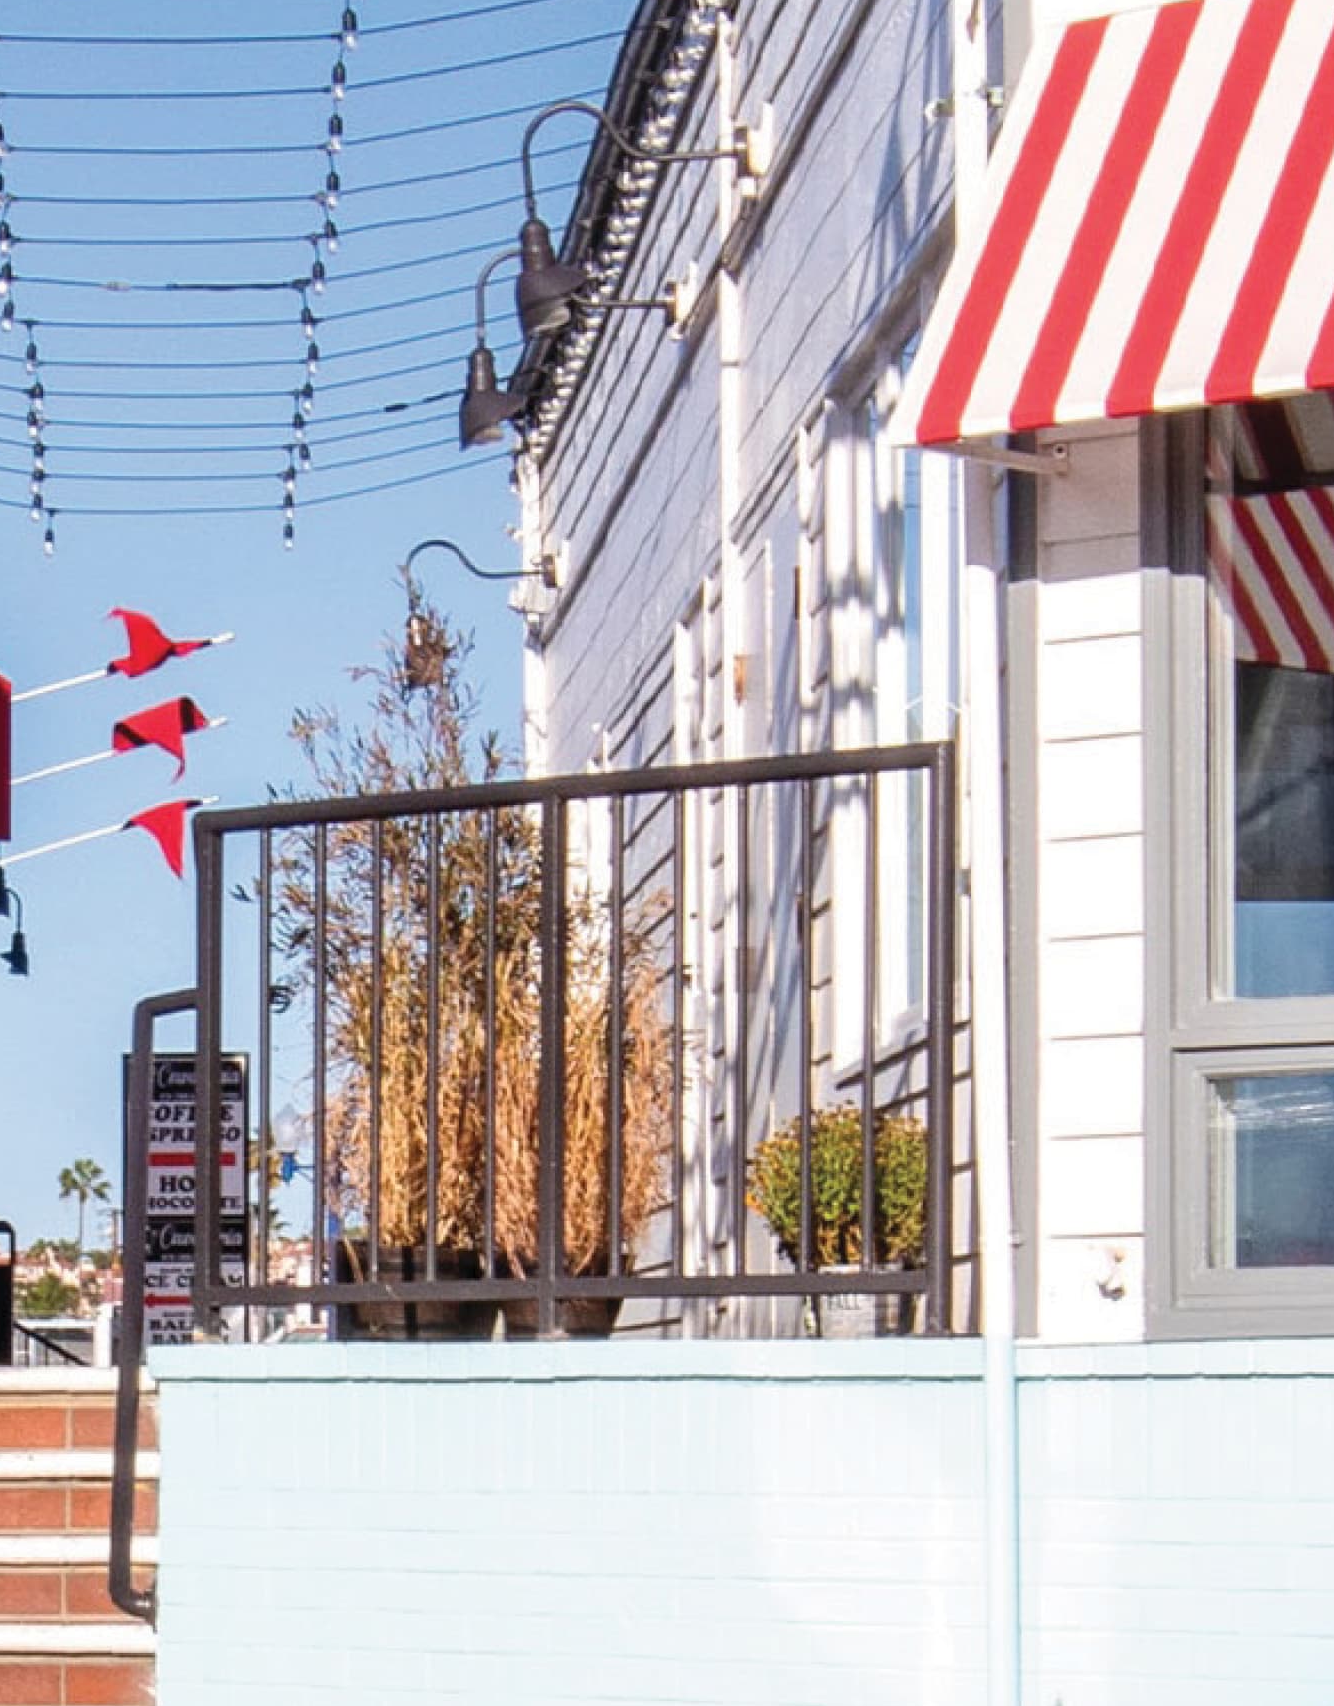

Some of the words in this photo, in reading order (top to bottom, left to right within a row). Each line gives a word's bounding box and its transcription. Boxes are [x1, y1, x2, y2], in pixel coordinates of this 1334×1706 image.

[154, 1105, 234, 1123] OFE
[159, 1175, 196, 1193] HO
[148, 1197, 241, 1209] OCOTE
